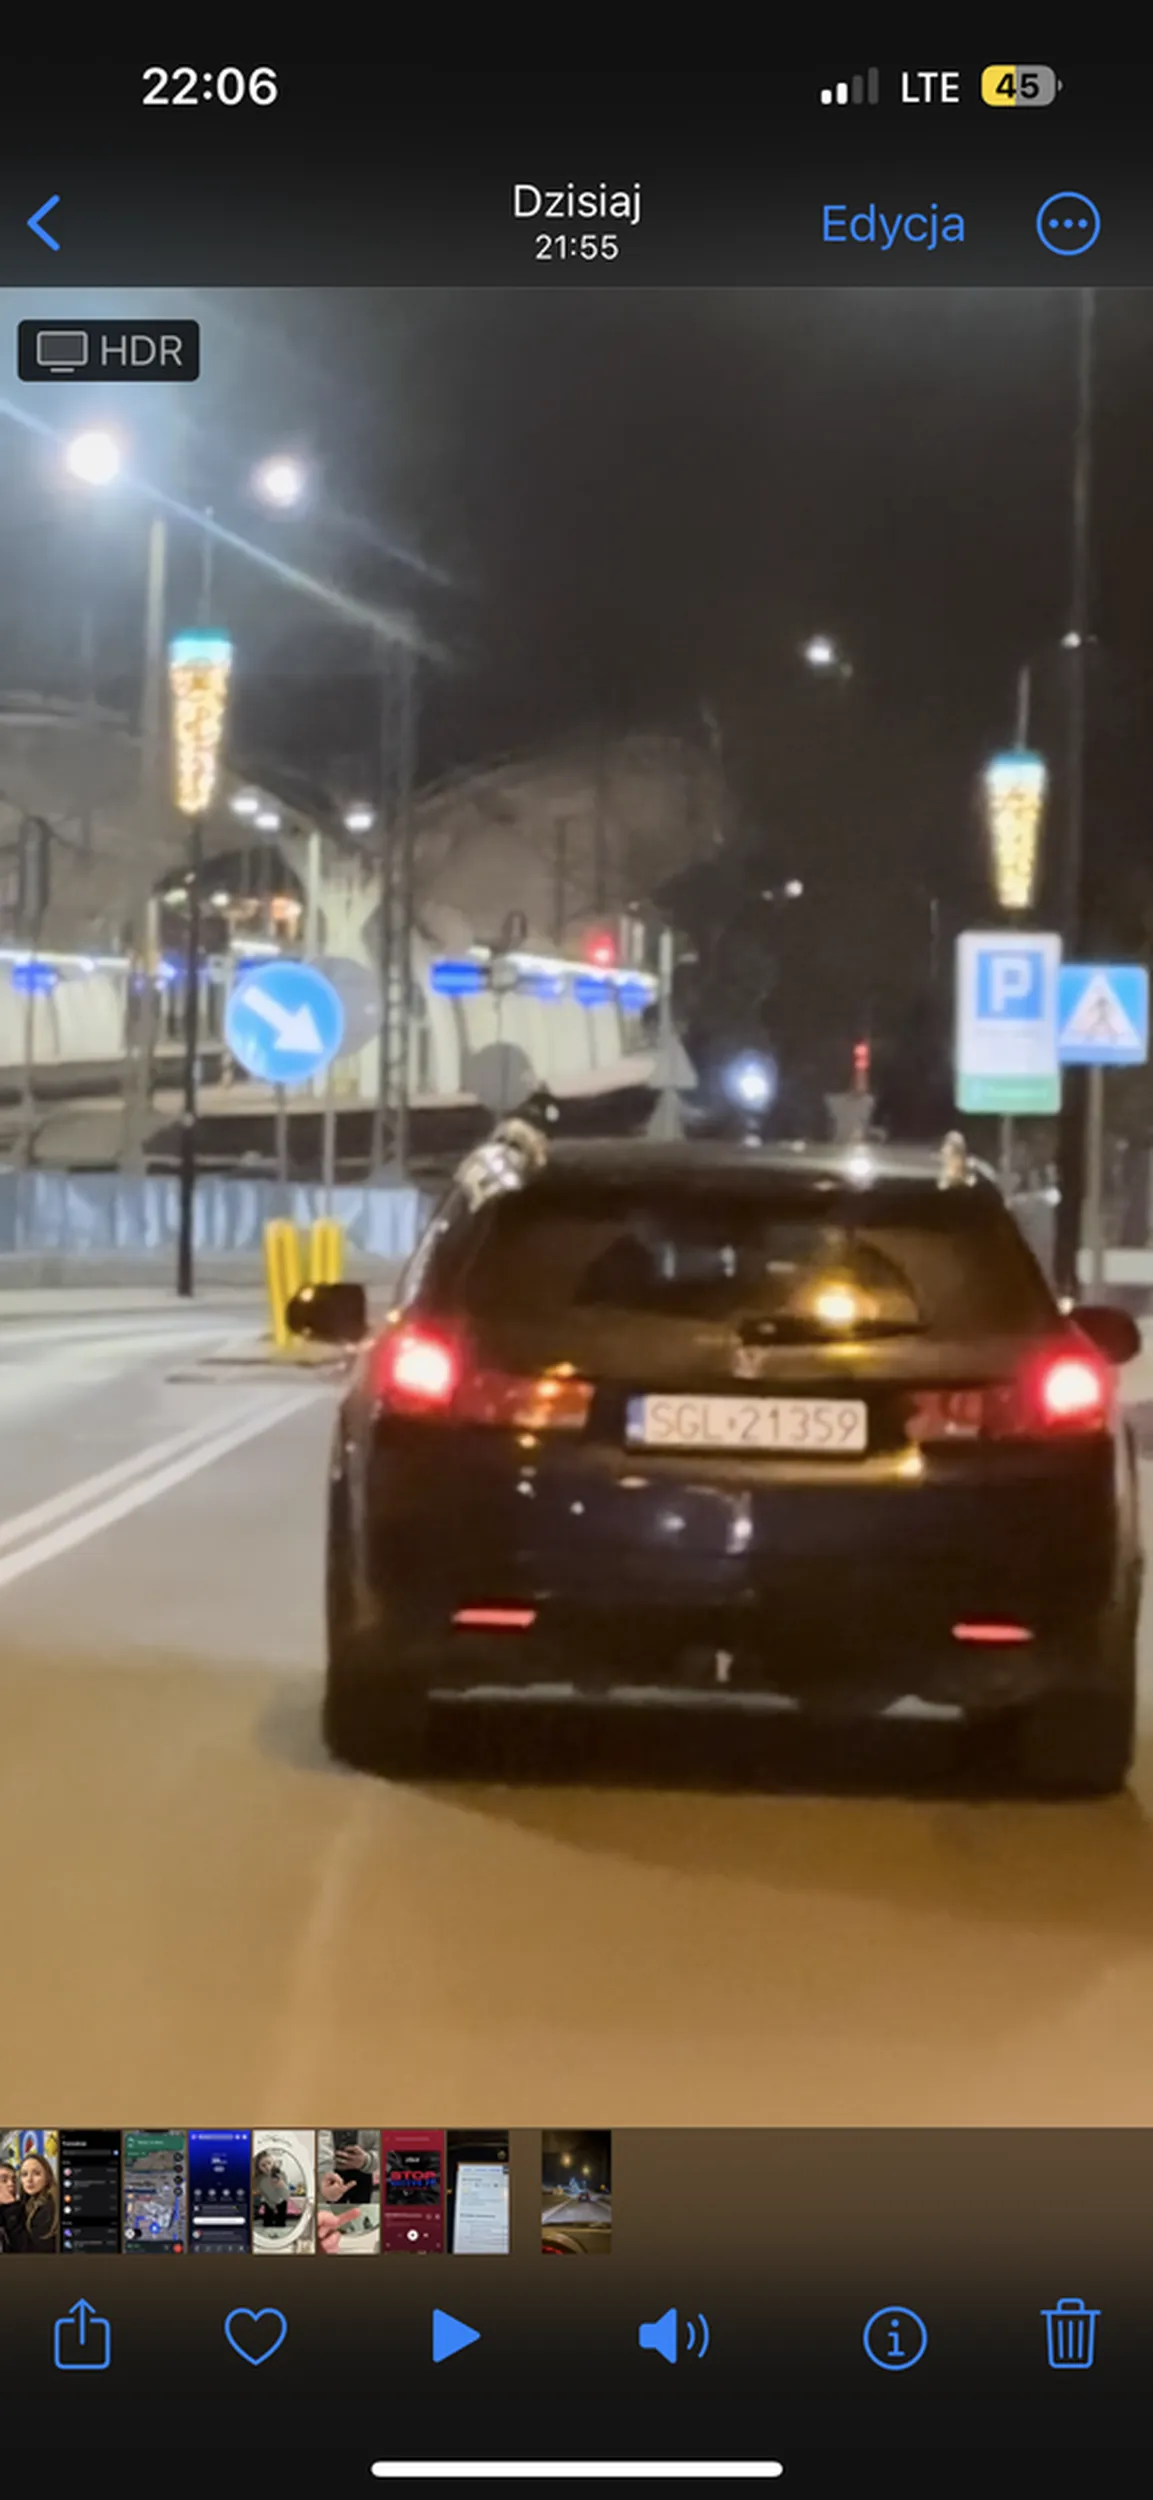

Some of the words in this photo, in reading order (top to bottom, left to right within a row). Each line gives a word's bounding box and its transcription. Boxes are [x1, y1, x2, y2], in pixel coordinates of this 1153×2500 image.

[142, 67, 278, 106] 22:06
[902, 71, 960, 104] LTE
[996, 73, 1040, 100] 45
[513, 183, 641, 225] Dzisiaj
[822, 204, 966, 249] Edycja
[535, 234, 619, 260] 21:55
[101, 334, 183, 366] HDR
[990, 957, 1032, 1012] P
[650, 1401, 723, 1440] SGL
[738, 1406, 860, 1443] 21359
